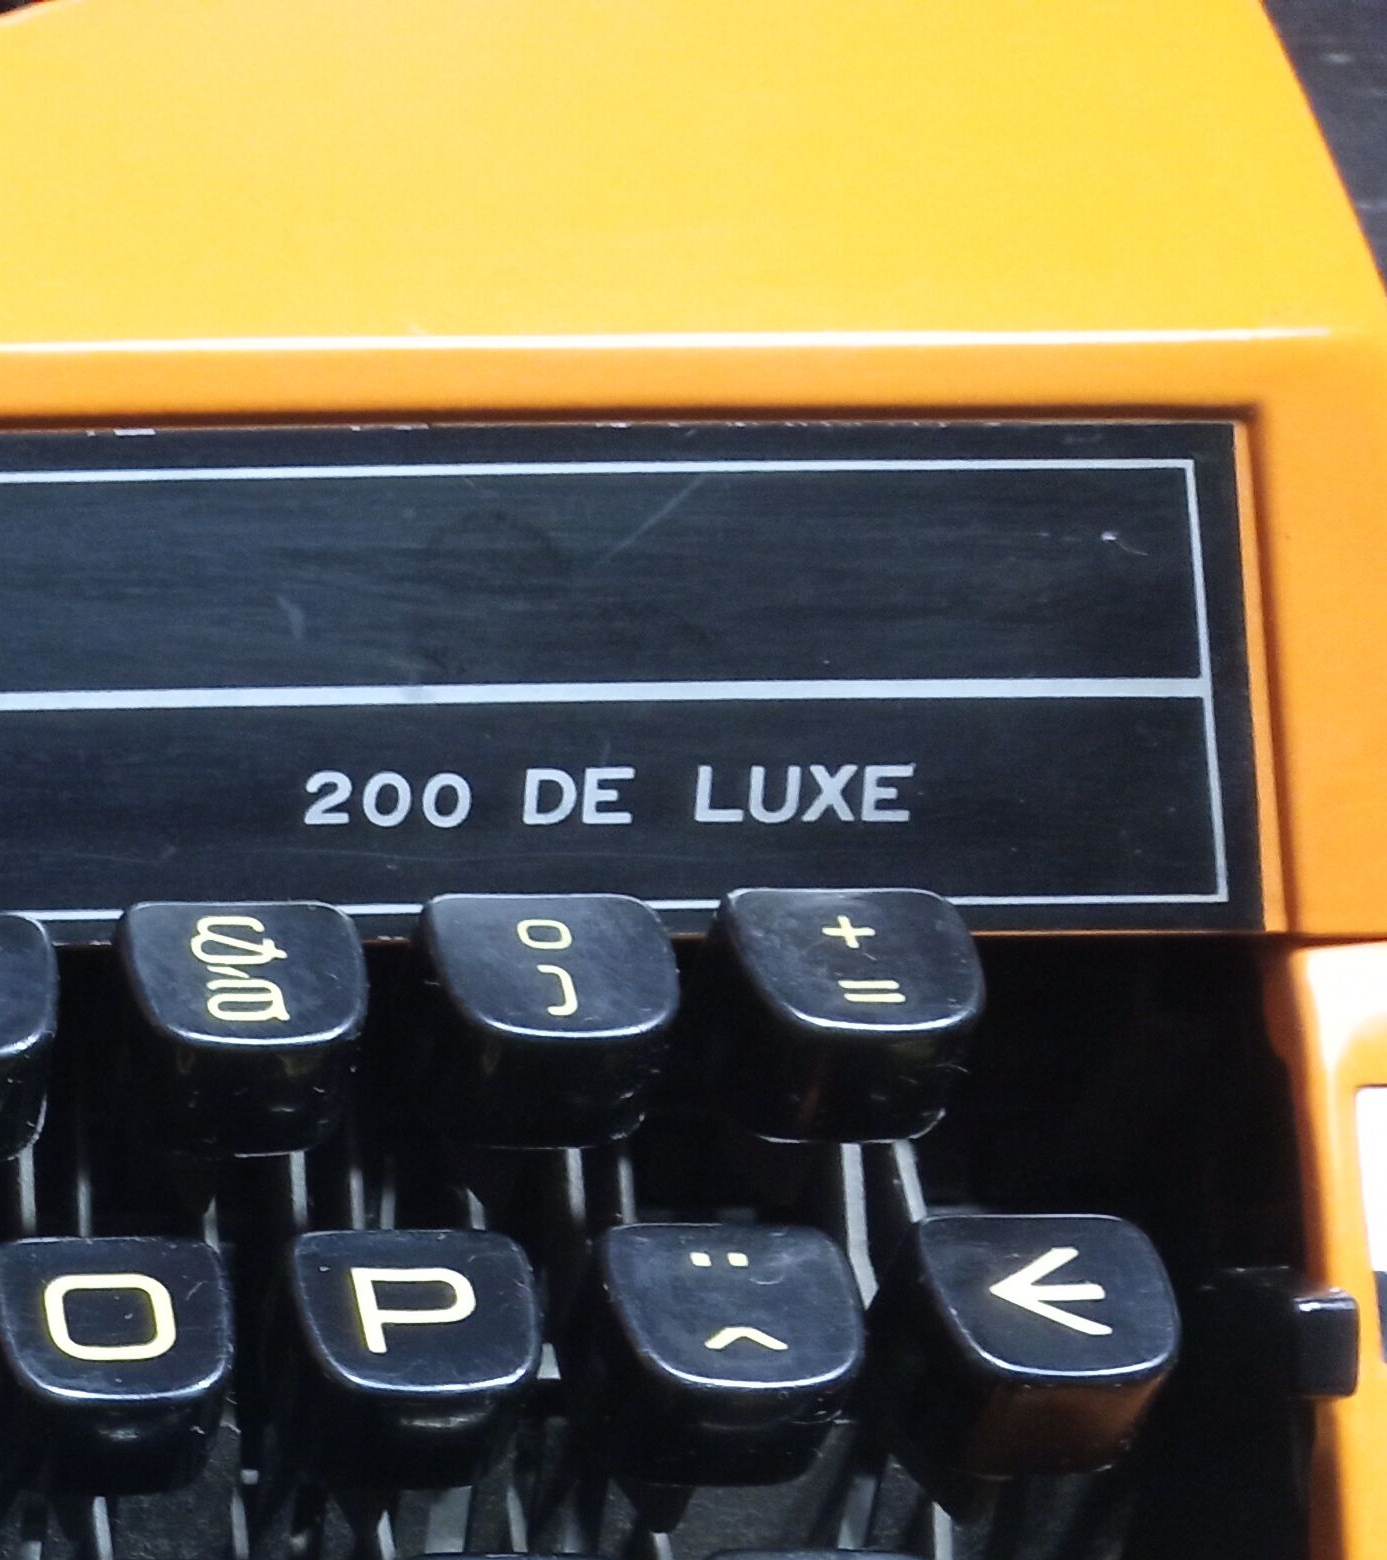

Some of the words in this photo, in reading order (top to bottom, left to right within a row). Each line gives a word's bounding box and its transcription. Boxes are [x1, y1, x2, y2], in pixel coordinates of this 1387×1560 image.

[303, 771, 472, 828] 200
[522, 767, 636, 825] DE
[694, 763, 917, 823] LUXE
[190, 915, 288, 965] &
[821, 915, 877, 949] +
[43, 1273, 177, 1361] O
[350, 1267, 477, 1354] P
